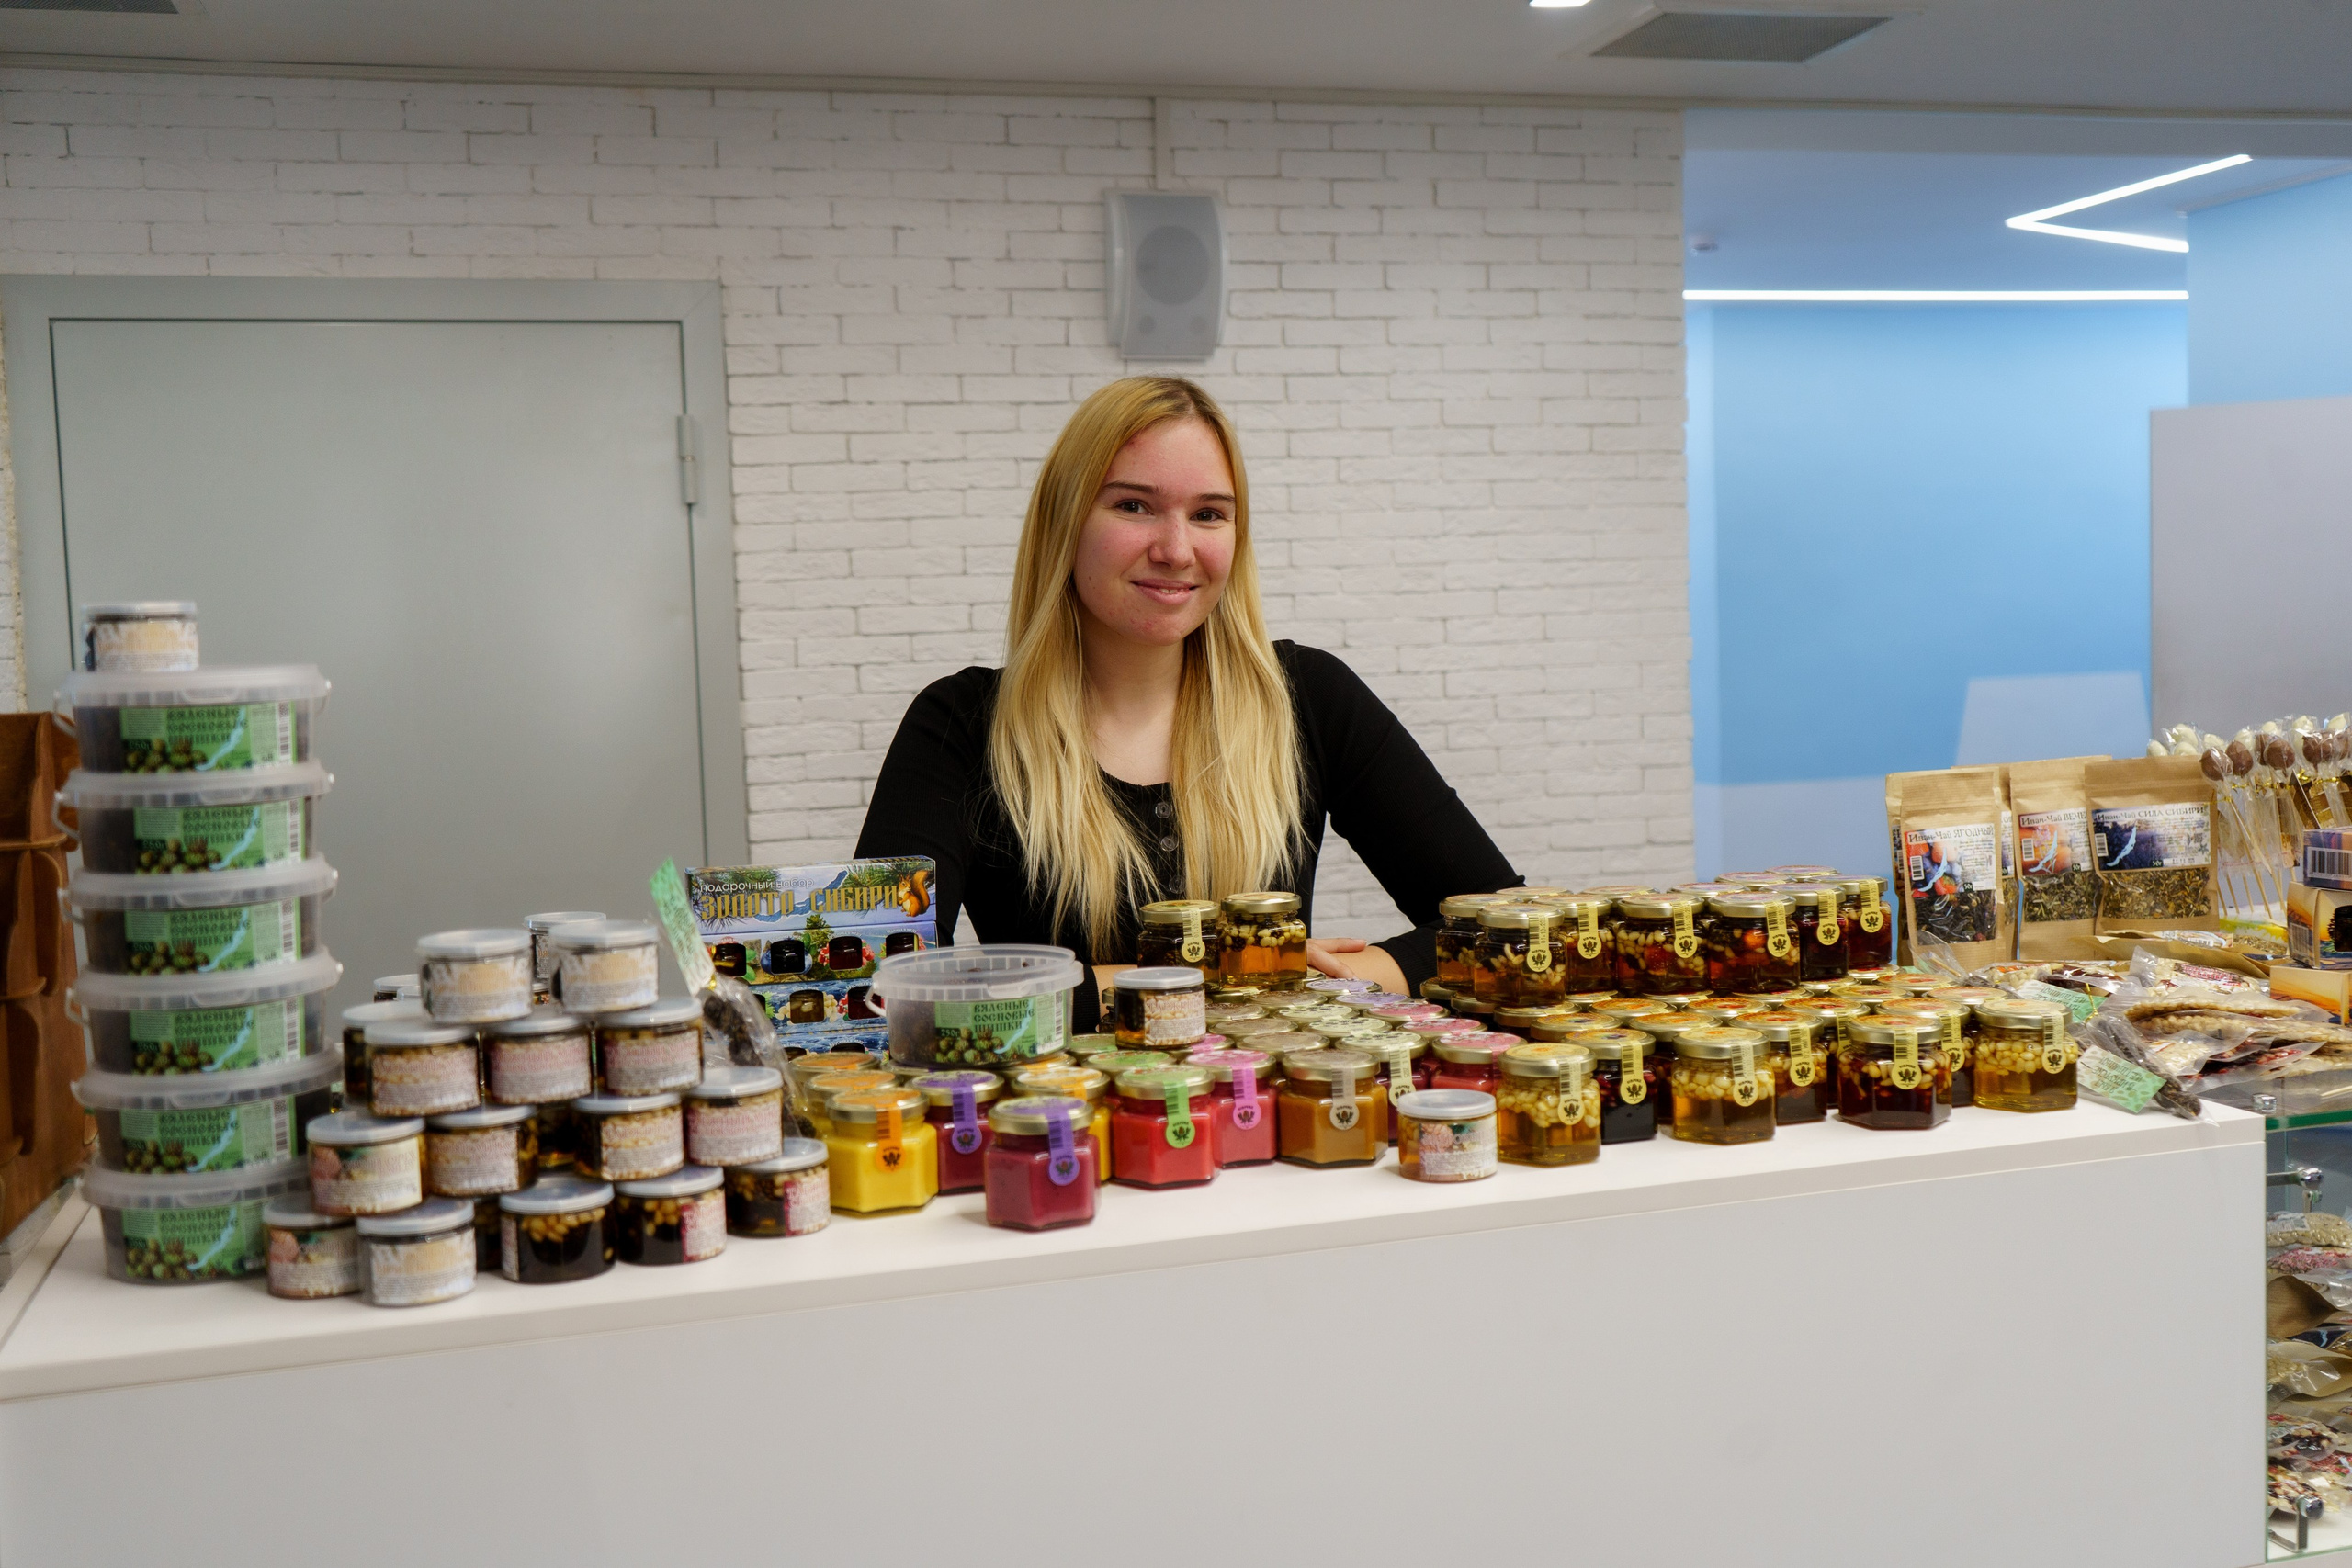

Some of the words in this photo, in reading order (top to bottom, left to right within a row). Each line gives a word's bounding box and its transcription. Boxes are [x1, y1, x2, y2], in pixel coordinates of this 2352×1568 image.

[2021, 814, 2062, 826] Иван-Чай
[2098, 812, 2136, 821] Иван-Чай
[2138, 808, 2164, 818] СИЛА
[2165, 807, 2204, 816] СИБИРИ
[1908, 830, 1952, 842] Иван-Чай
[1954, 826, 1994, 838] ЯГОДНЫЙ
[700, 879, 773, 893] подарочный
[775, 877, 814, 889] набор
[701, 889, 795, 919] ЗОЛОТО
[810, 886, 898, 913] СИБИРИ
[974, 999, 1030, 1013] ВЯЛЕНЫЕ
[974, 1009, 1035, 1022] СОСНОВЫЕ
[941, 1029, 960, 1038] 250г
[975, 1020, 1023, 1033] ШИШКИ
